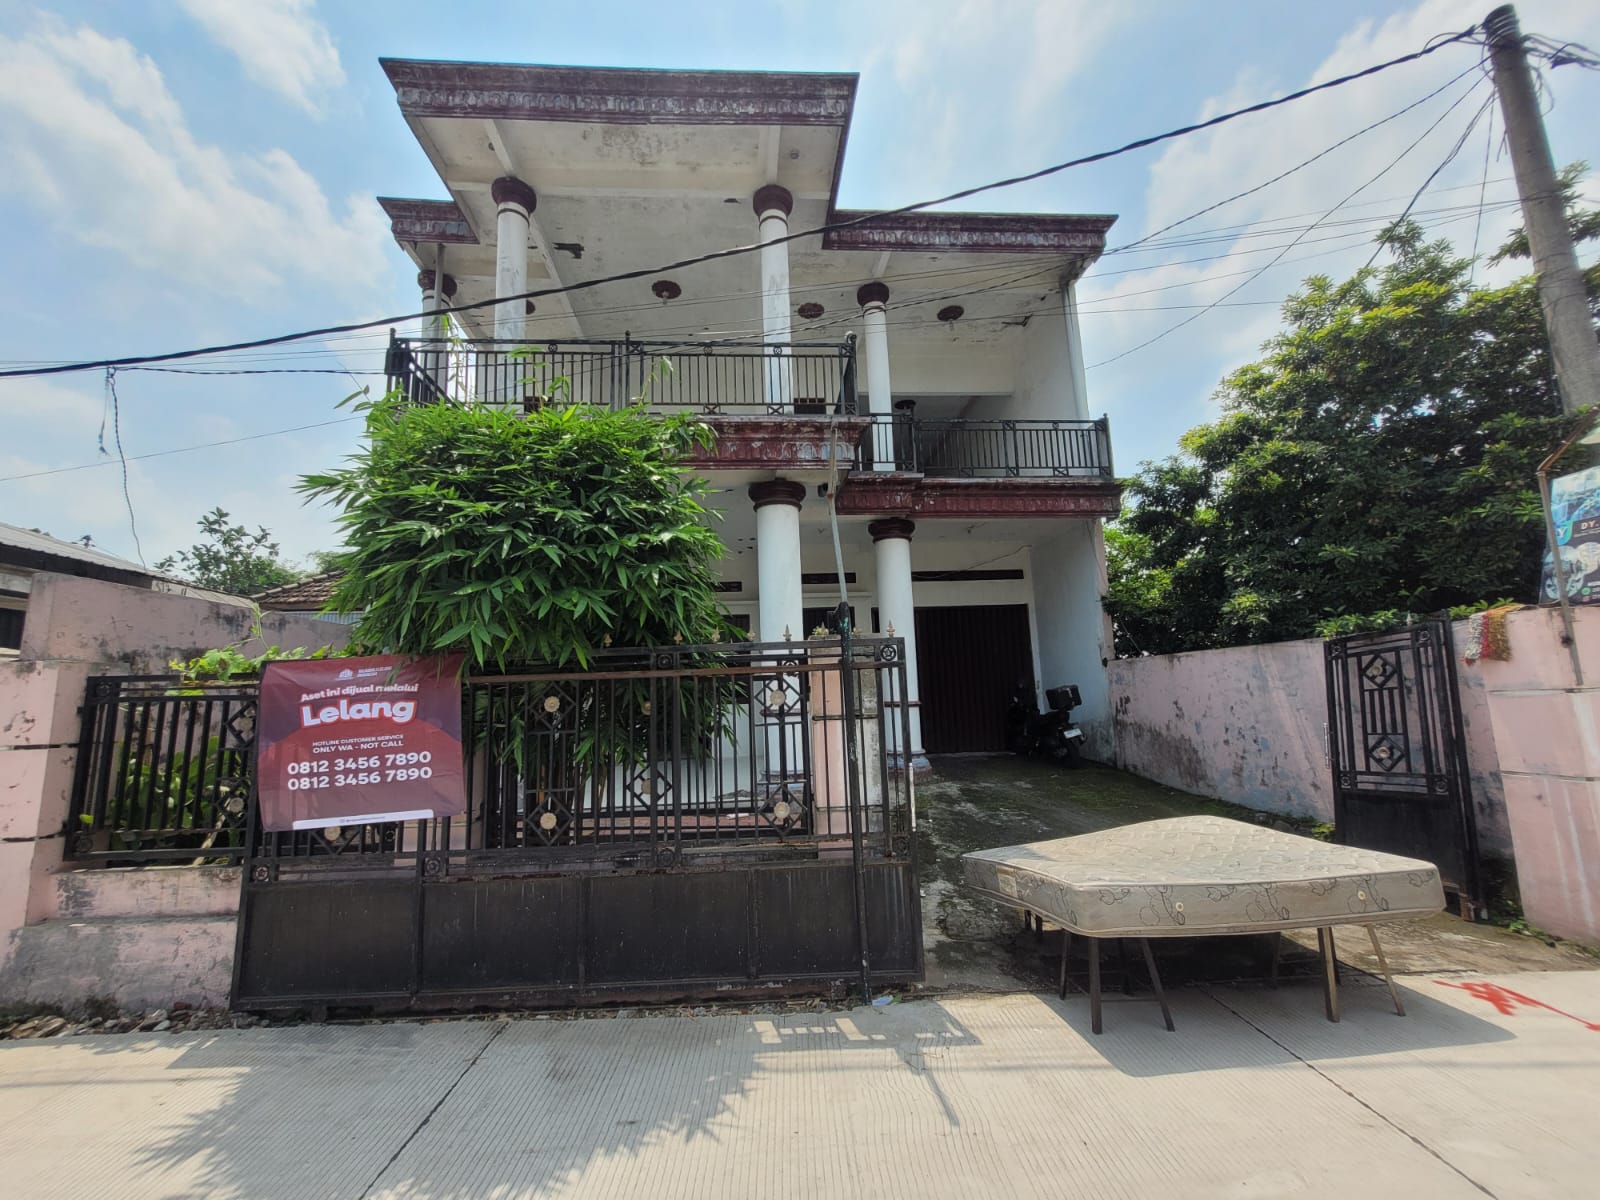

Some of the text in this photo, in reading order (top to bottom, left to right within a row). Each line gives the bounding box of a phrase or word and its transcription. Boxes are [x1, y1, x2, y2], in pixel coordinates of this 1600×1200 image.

[301, 684, 419, 702] Aset ini dijual melalui
[302, 699, 414, 726] Lelang
[313, 746, 335, 754] ONLY
[288, 751, 431, 774] 0812 3456 7890
[288, 767, 432, 790] 0812 3456 7890
